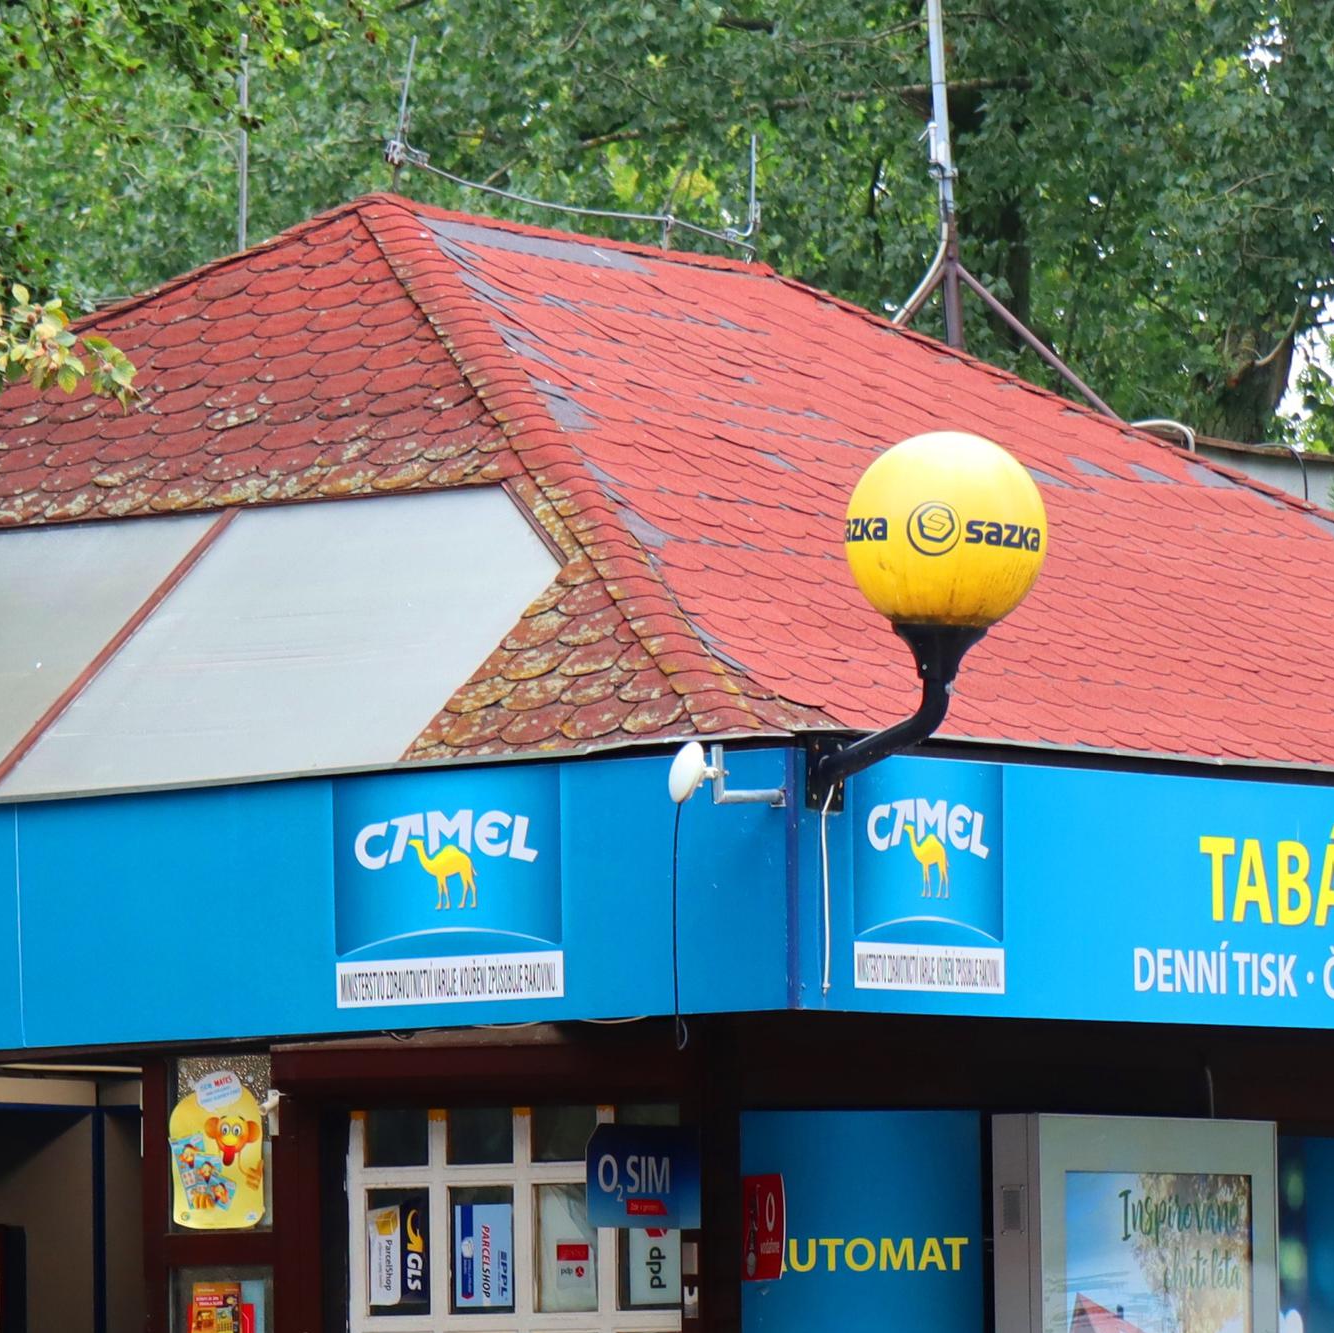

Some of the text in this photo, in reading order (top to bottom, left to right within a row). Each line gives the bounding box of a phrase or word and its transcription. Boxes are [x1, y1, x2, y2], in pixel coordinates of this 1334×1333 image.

[845, 517, 888, 543] azka
[354, 809, 538, 870] CAMEL
[867, 798, 989, 859] CAMEL
[1133, 941, 1230, 994] DENNÍ
[1233, 952, 1297, 998] TISK
[626, 1155, 670, 1194] SIM
[384, 1239, 393, 1291] ParcelShop
[407, 1253, 424, 1291] GLS
[482, 1224, 491, 1298] PARCELSHOP
[781, 1237, 969, 1273] UTOMAT
